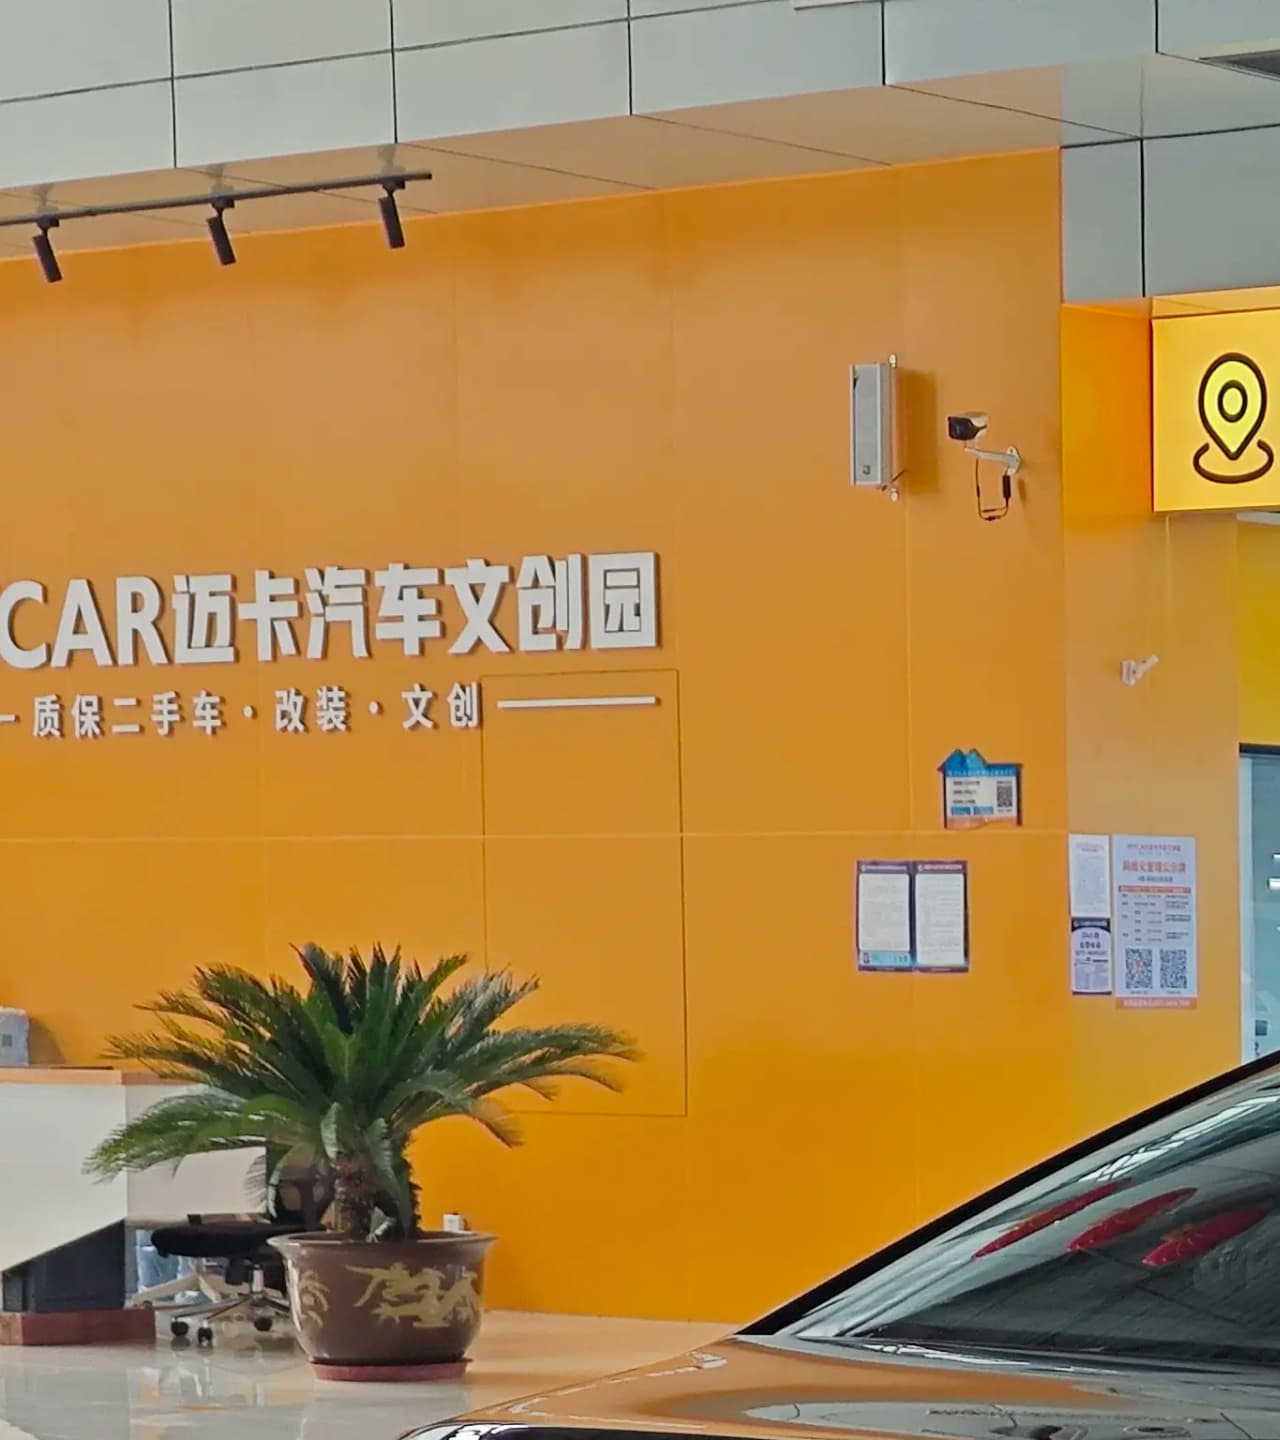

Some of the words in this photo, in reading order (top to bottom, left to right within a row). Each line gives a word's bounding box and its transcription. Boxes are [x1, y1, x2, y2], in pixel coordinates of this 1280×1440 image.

[0, 552, 658, 669] CAR迈卡汽车文创园
